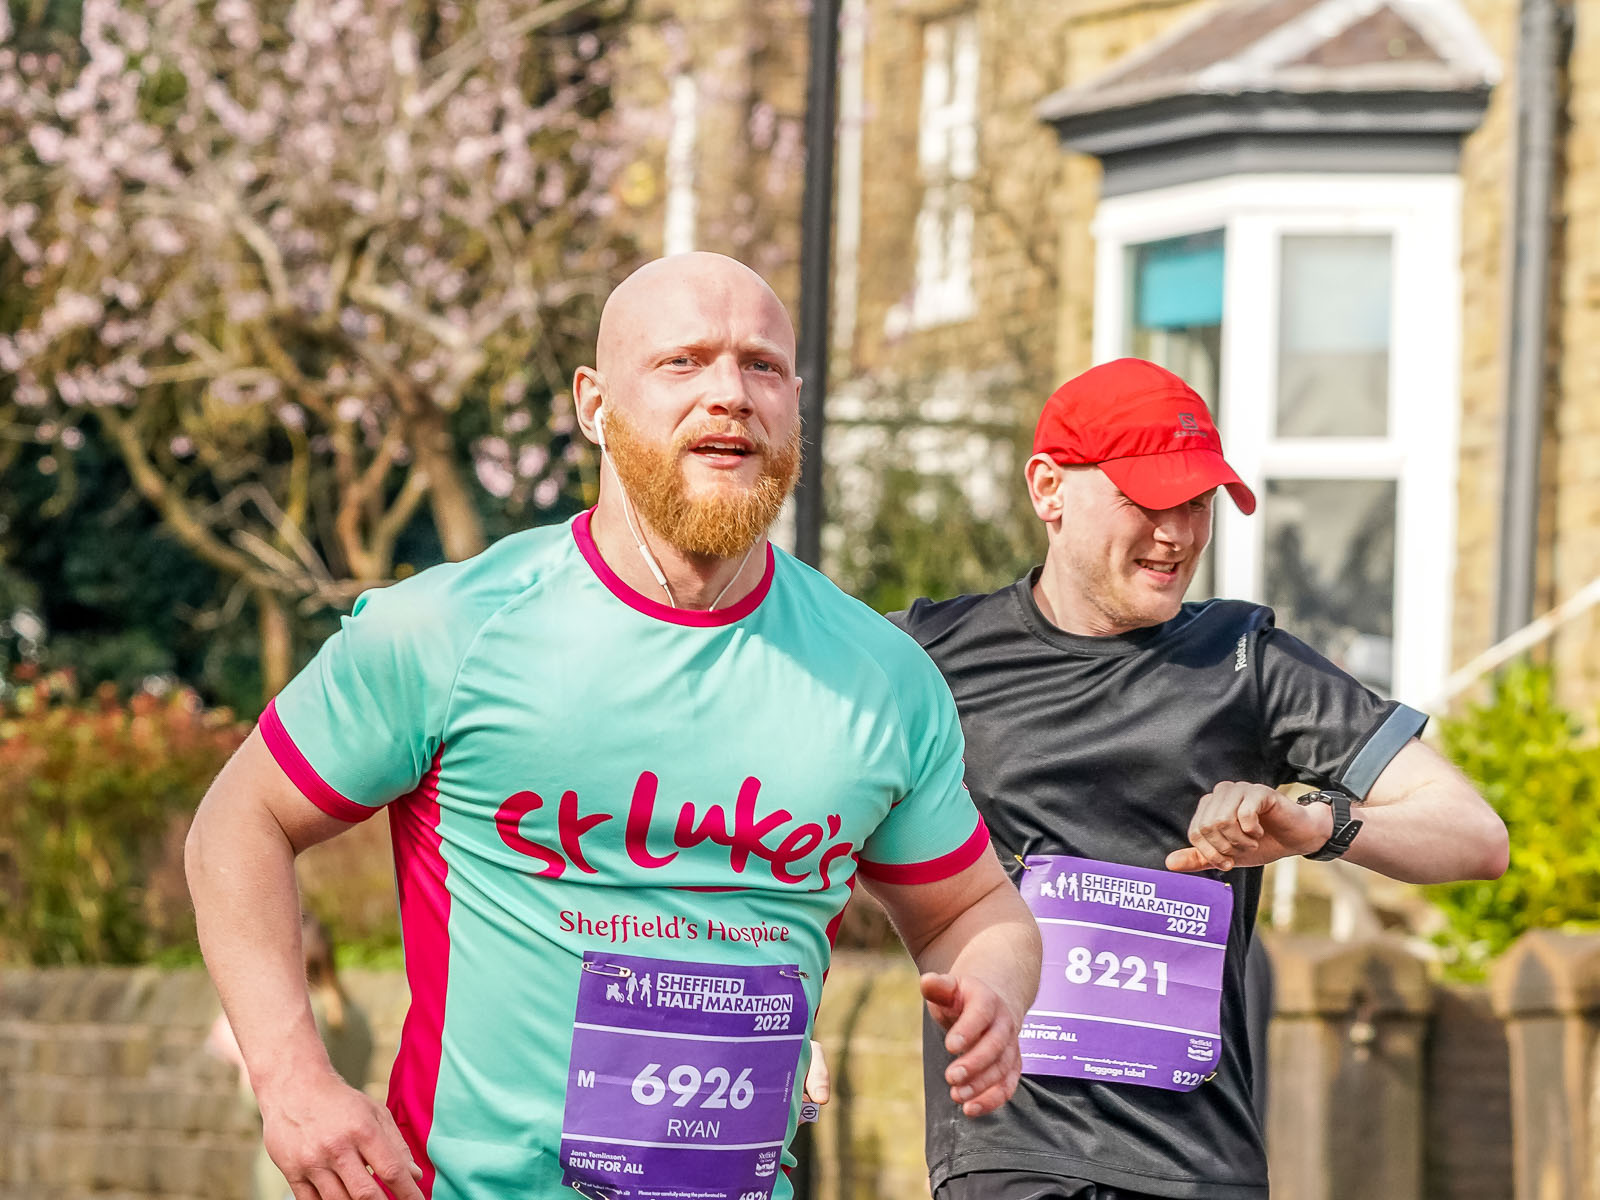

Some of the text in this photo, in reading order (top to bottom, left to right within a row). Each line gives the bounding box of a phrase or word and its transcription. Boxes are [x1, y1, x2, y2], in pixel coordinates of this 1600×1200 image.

[494, 770, 854, 893] St Luke's
[1083, 875, 1153, 896] SHEFFIELD
[1082, 888, 1208, 921] HALF MARATHON
[559, 910, 790, 948] Sheffield's Hospice
[1166, 917, 1208, 937] 2022
[1064, 946, 1168, 996] 8221
[658, 974, 743, 995] SHEFFIELD
[656, 991, 791, 1012] HALF MARATHON
[753, 1014, 791, 1032] 2022
[1018, 1029, 1078, 1042] UN FOR ALL
[577, 1070, 596, 1089] M
[1083, 1063, 1146, 1079] Baggage label
[631, 1063, 755, 1110] 6926
[667, 1119, 720, 1138] RYAN
[570, 1149, 627, 1162] Jane Tomlinson's
[568, 1157, 644, 1175] RUN FOR ALL
